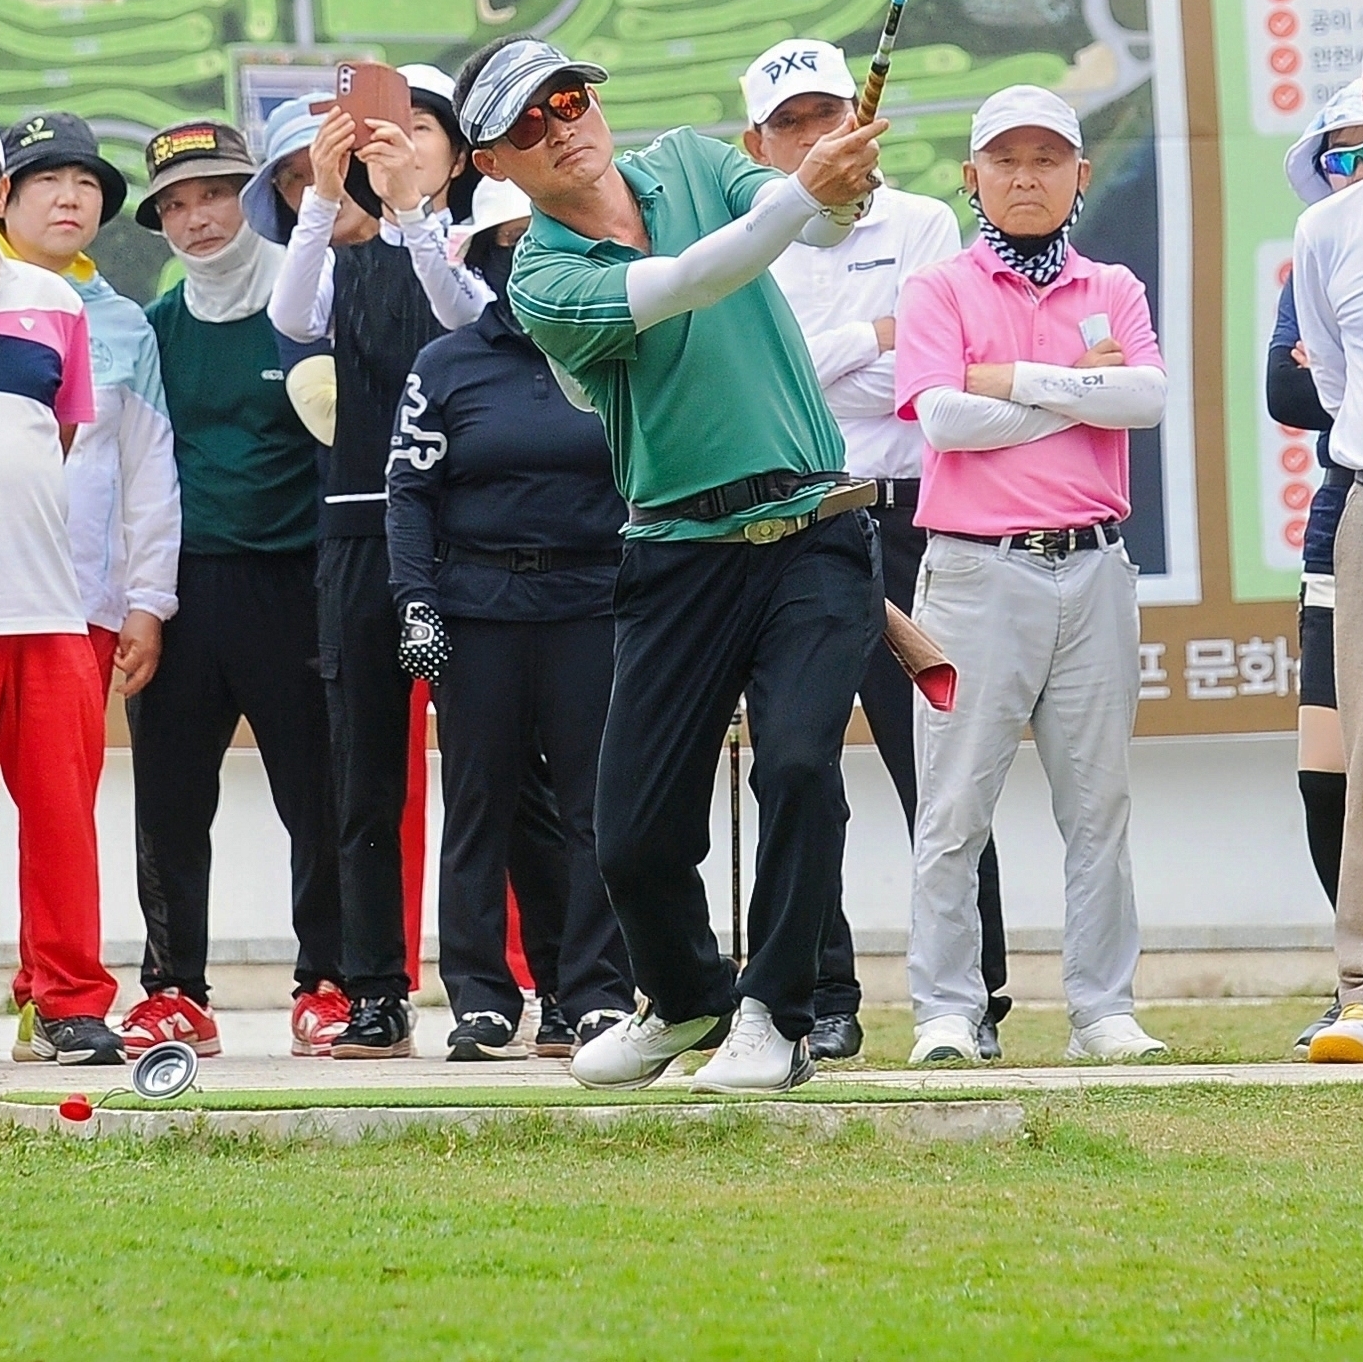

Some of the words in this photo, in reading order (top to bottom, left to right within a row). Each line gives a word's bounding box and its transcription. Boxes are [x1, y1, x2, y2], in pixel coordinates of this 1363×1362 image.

[762, 51, 819, 84] PXG
[1082, 374, 1104, 386] K2
[1184, 634, 1300, 701] 문화
